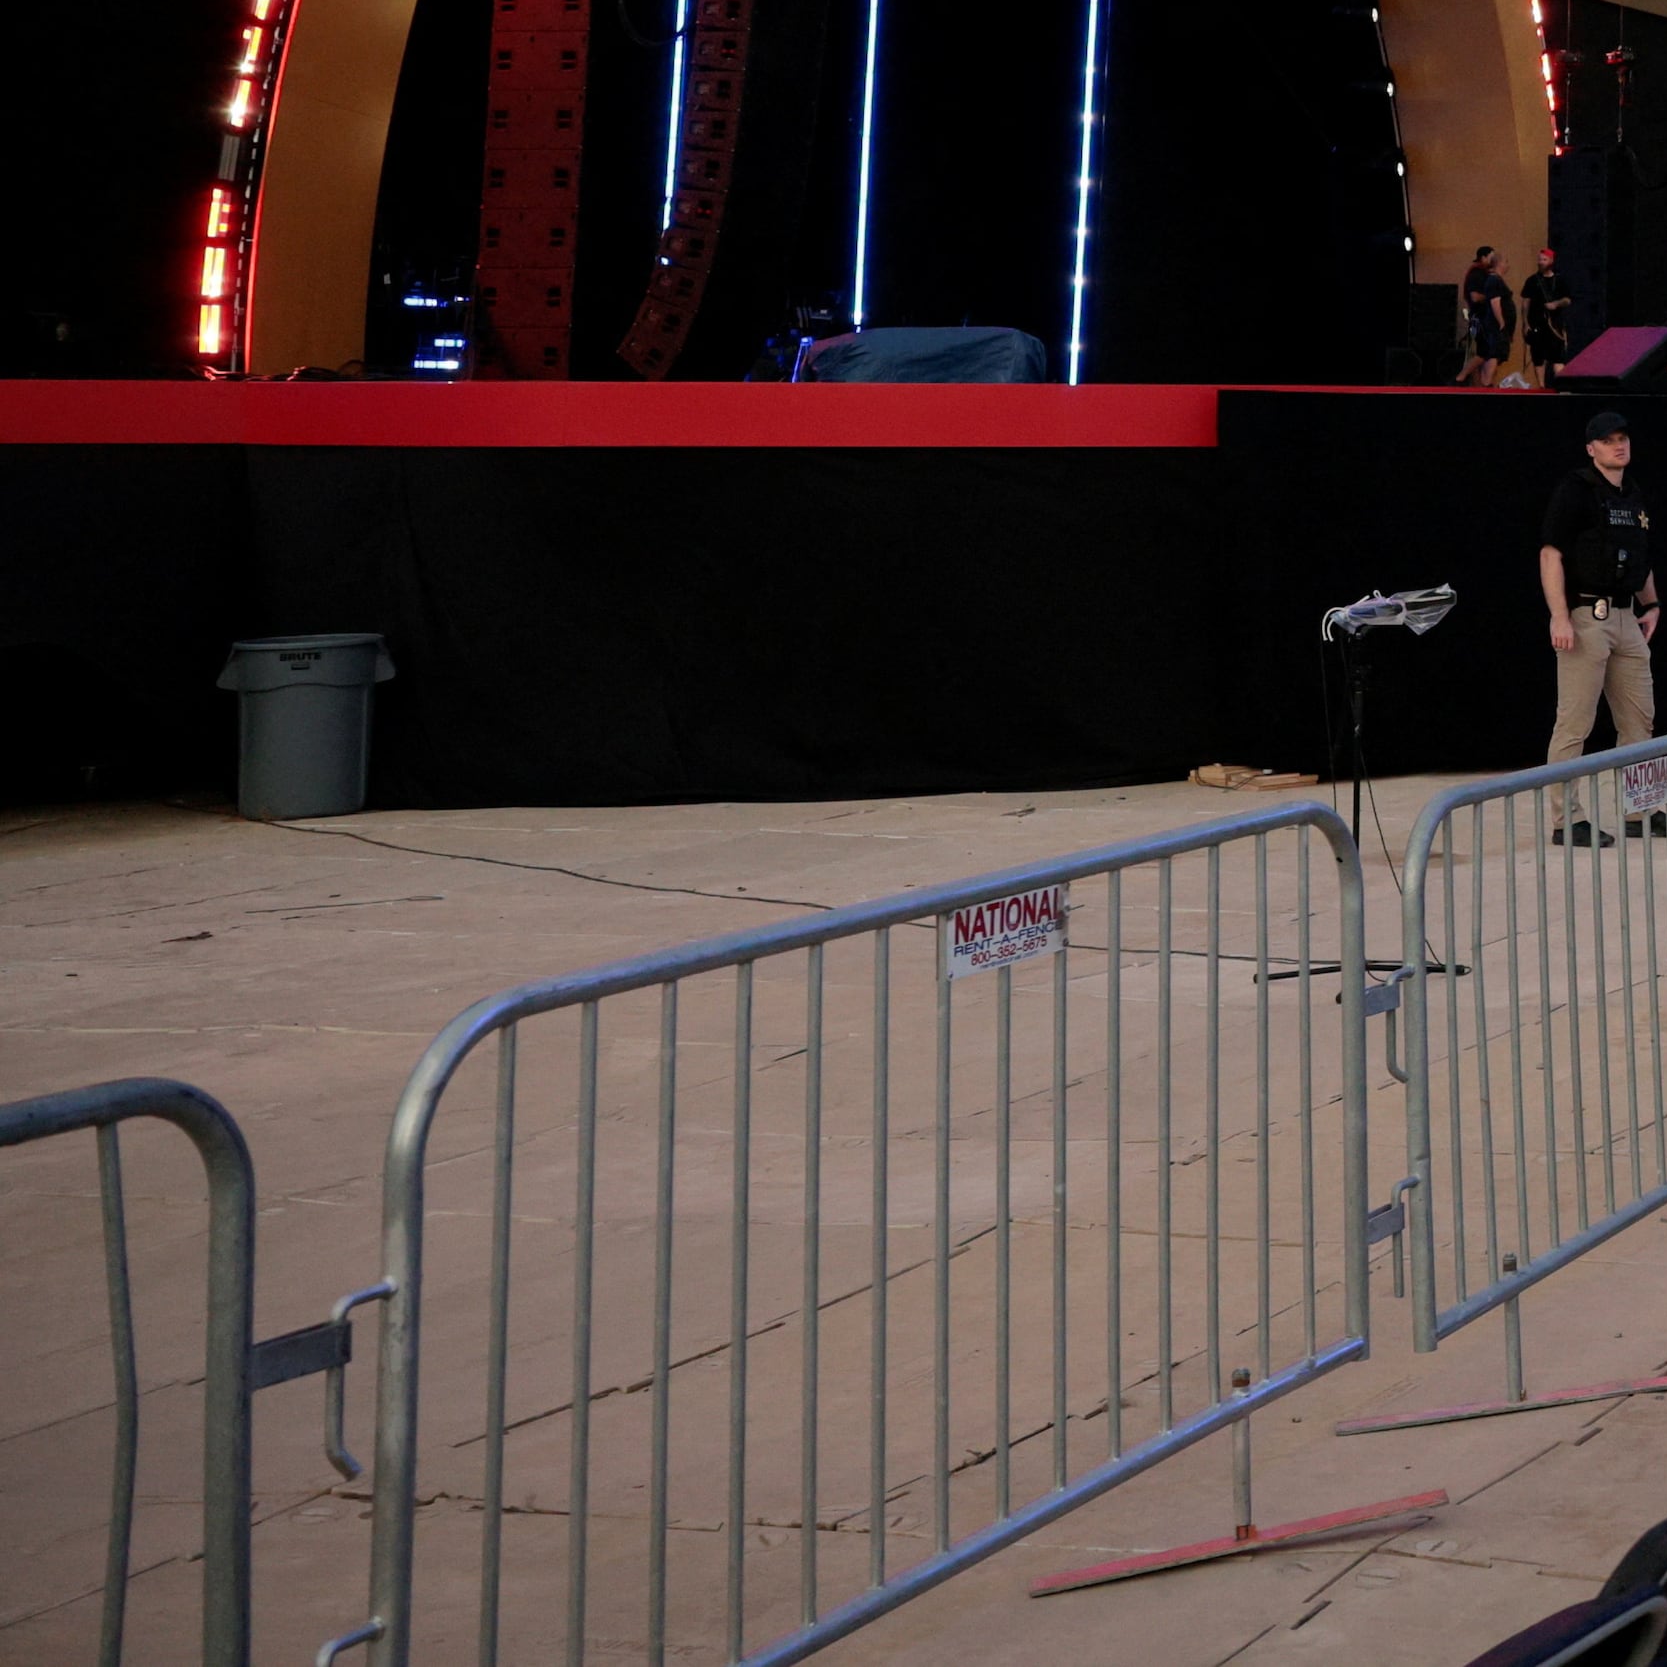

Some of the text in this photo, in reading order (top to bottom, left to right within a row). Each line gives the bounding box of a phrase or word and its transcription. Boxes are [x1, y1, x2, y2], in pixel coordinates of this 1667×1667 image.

[280, 652, 321, 662] BRUTE
[954, 887, 1060, 945] NATIONAL
[953, 920, 1062, 957] RENT-A-FENCE
[971, 935, 1048, 966] 800-352-5675
